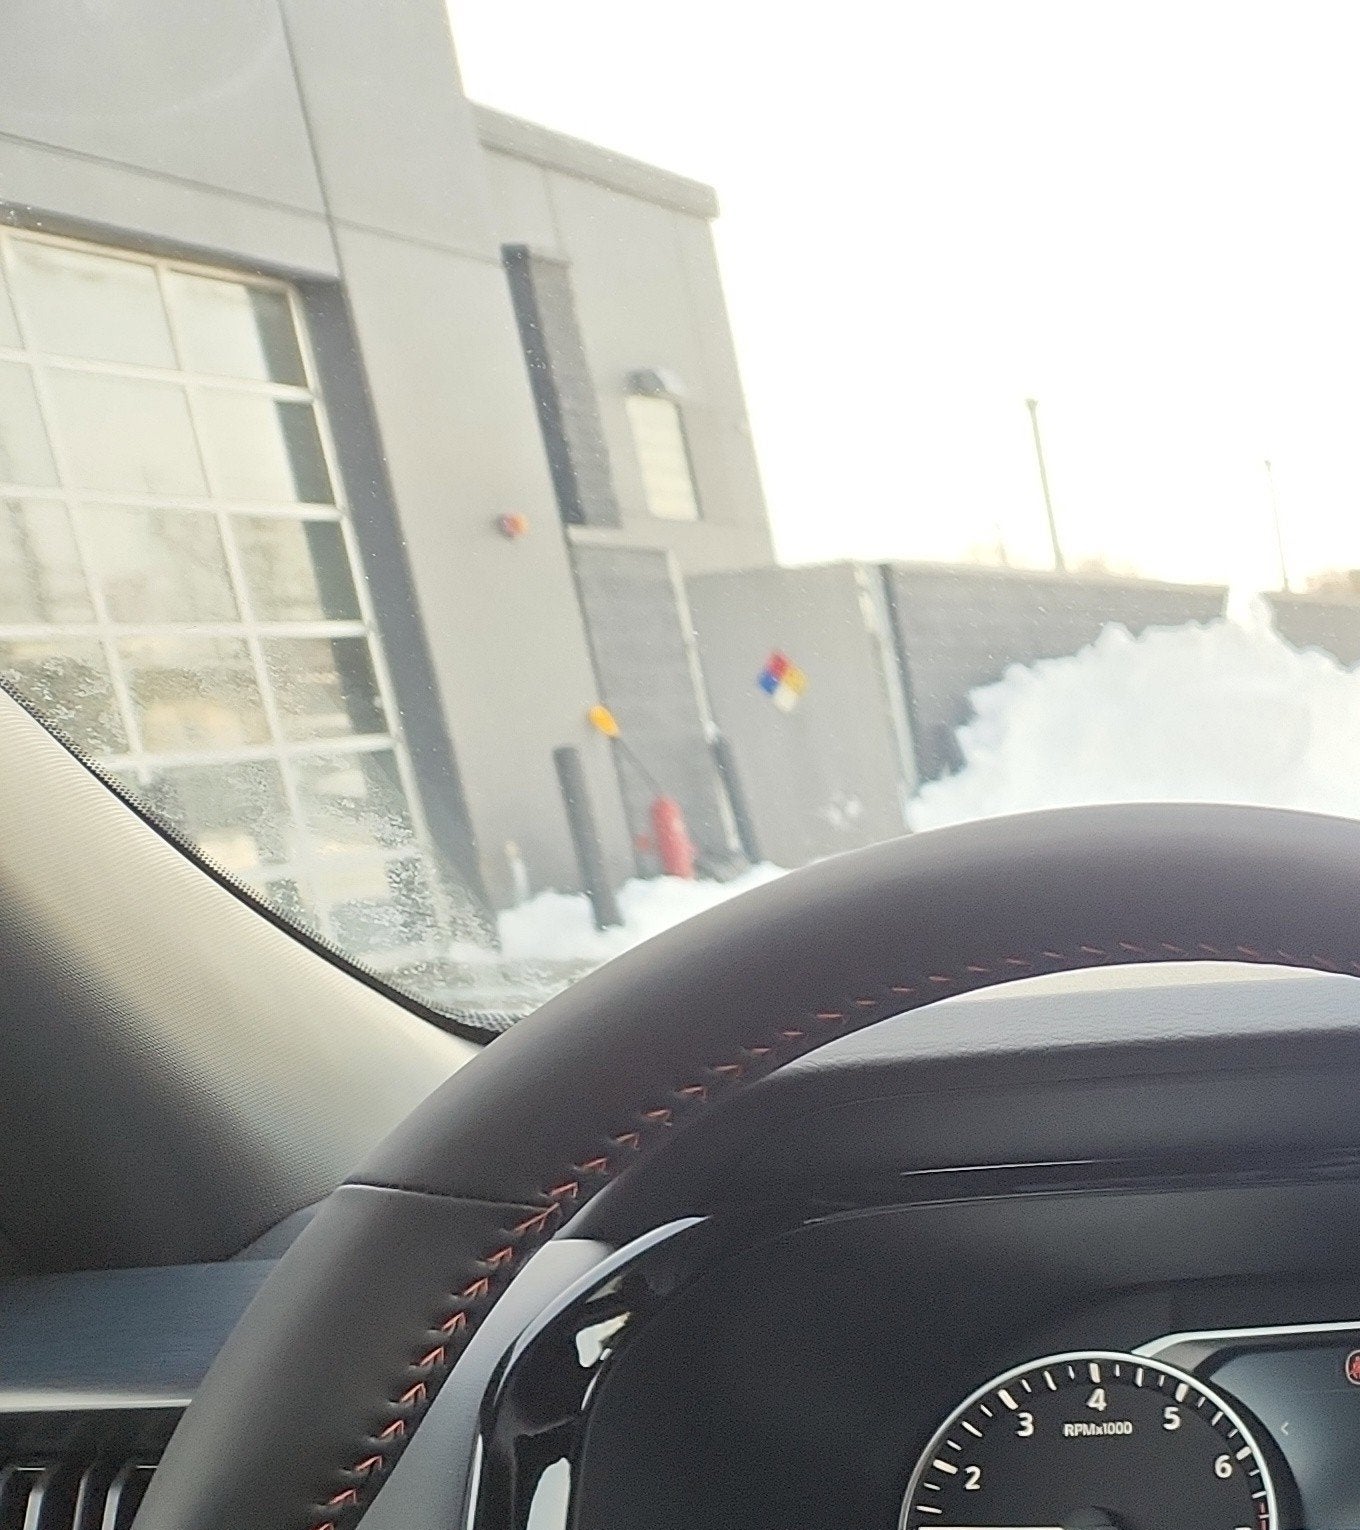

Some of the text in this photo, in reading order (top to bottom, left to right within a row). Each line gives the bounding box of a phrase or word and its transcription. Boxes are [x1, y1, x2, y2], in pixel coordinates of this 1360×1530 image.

[1087, 1388, 1107, 1411] 4
[1018, 1413, 1034, 1437] 3
[1163, 1406, 1180, 1430] 5
[964, 1465, 981, 1490] 2
[1214, 1453, 1232, 1478] 6
